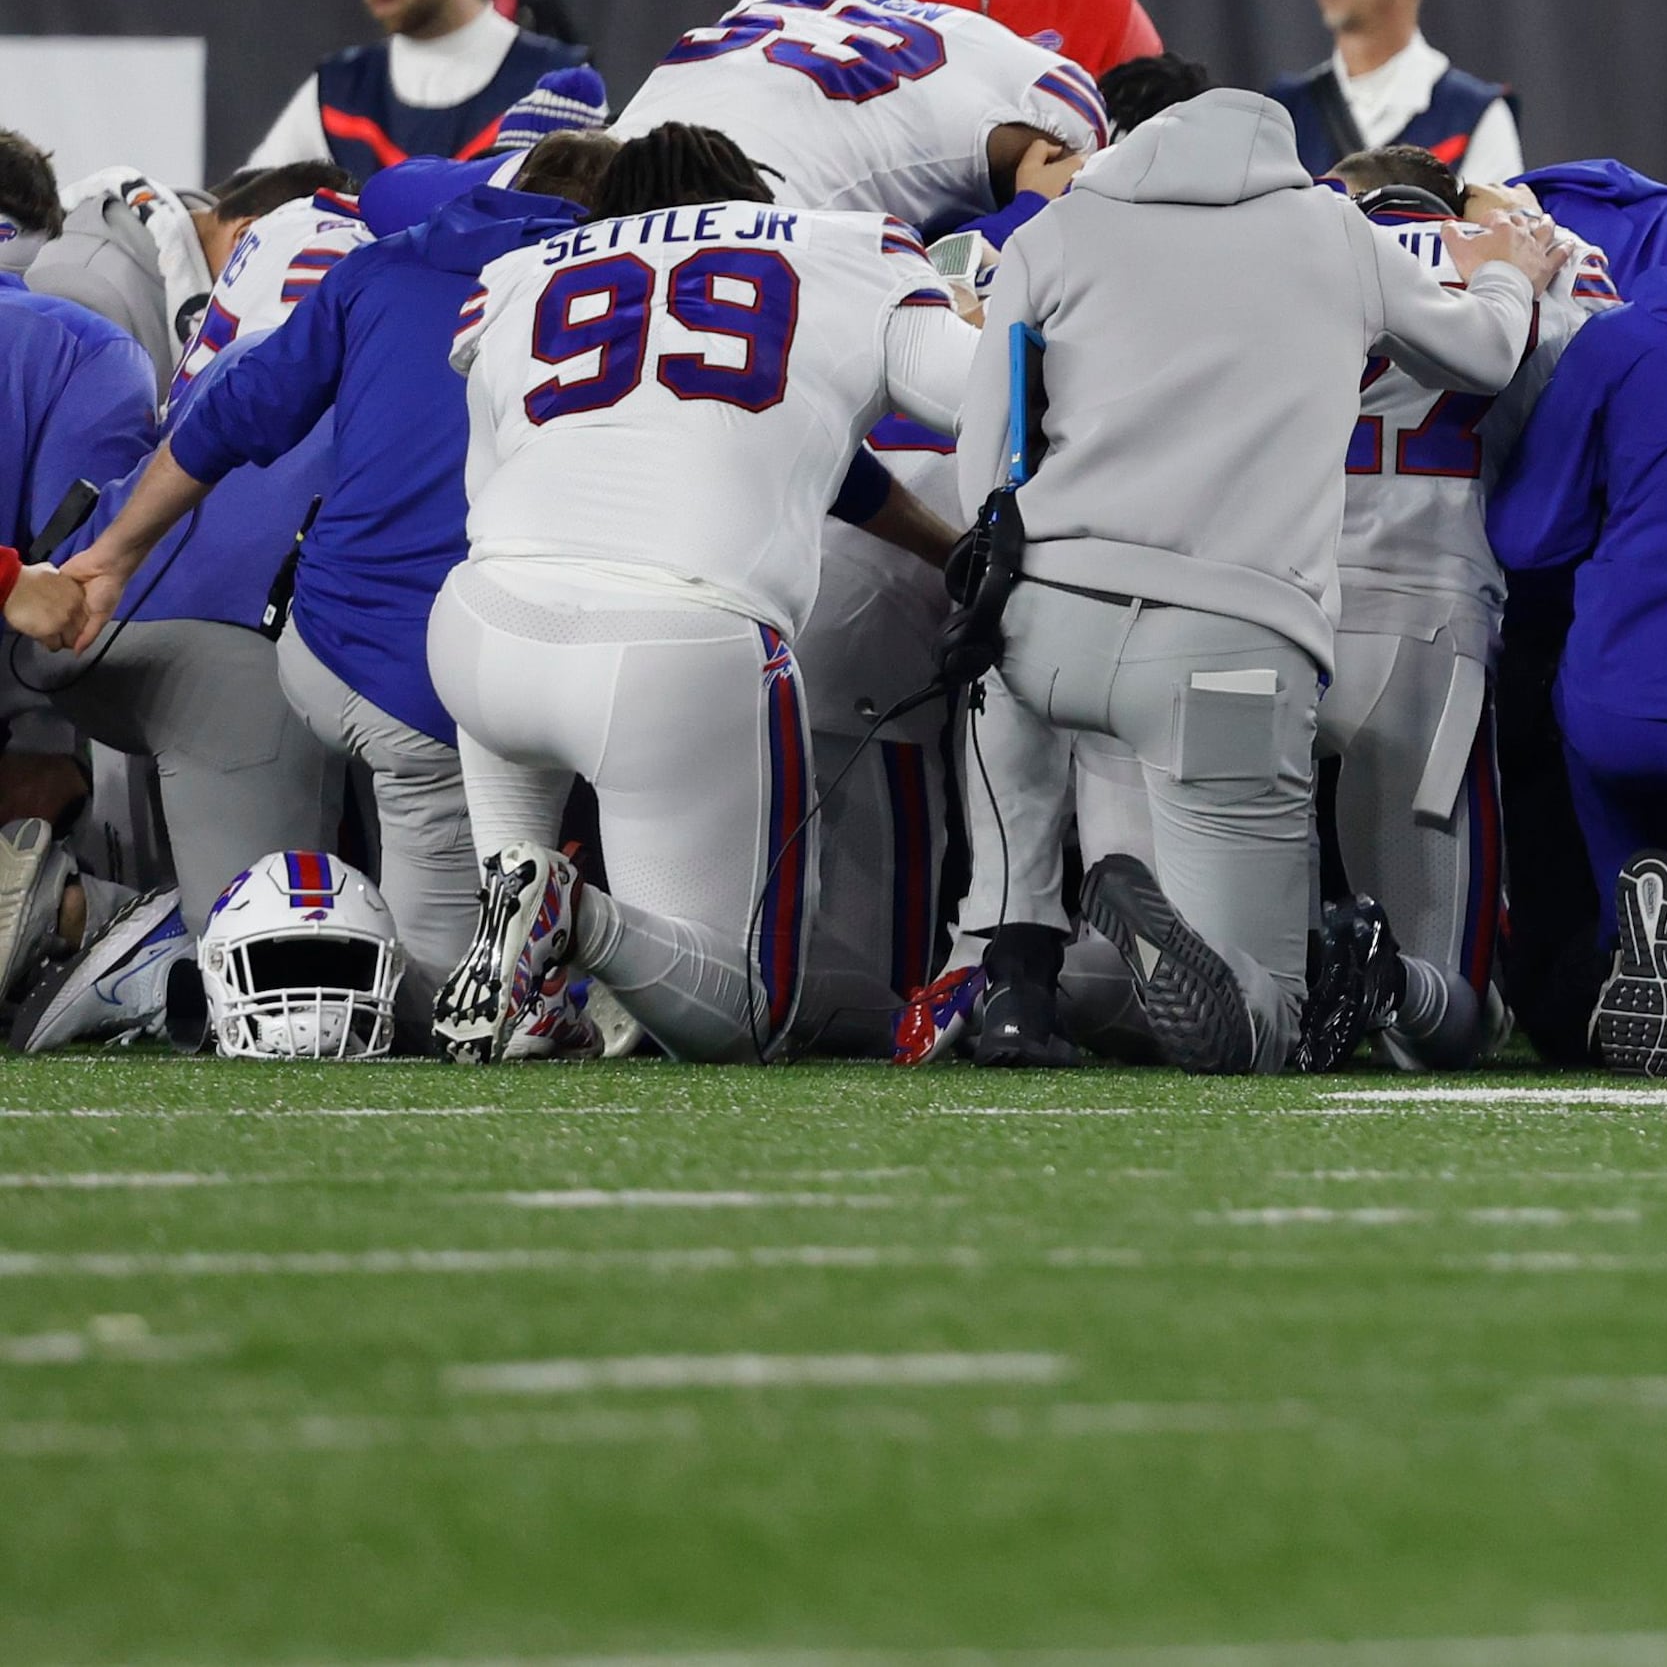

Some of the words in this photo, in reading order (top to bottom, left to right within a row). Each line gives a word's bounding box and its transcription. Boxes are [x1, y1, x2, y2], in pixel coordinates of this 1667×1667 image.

[542, 206, 728, 267] SETTLE
[734, 209, 798, 243] JR
[524, 245, 801, 427] 99
